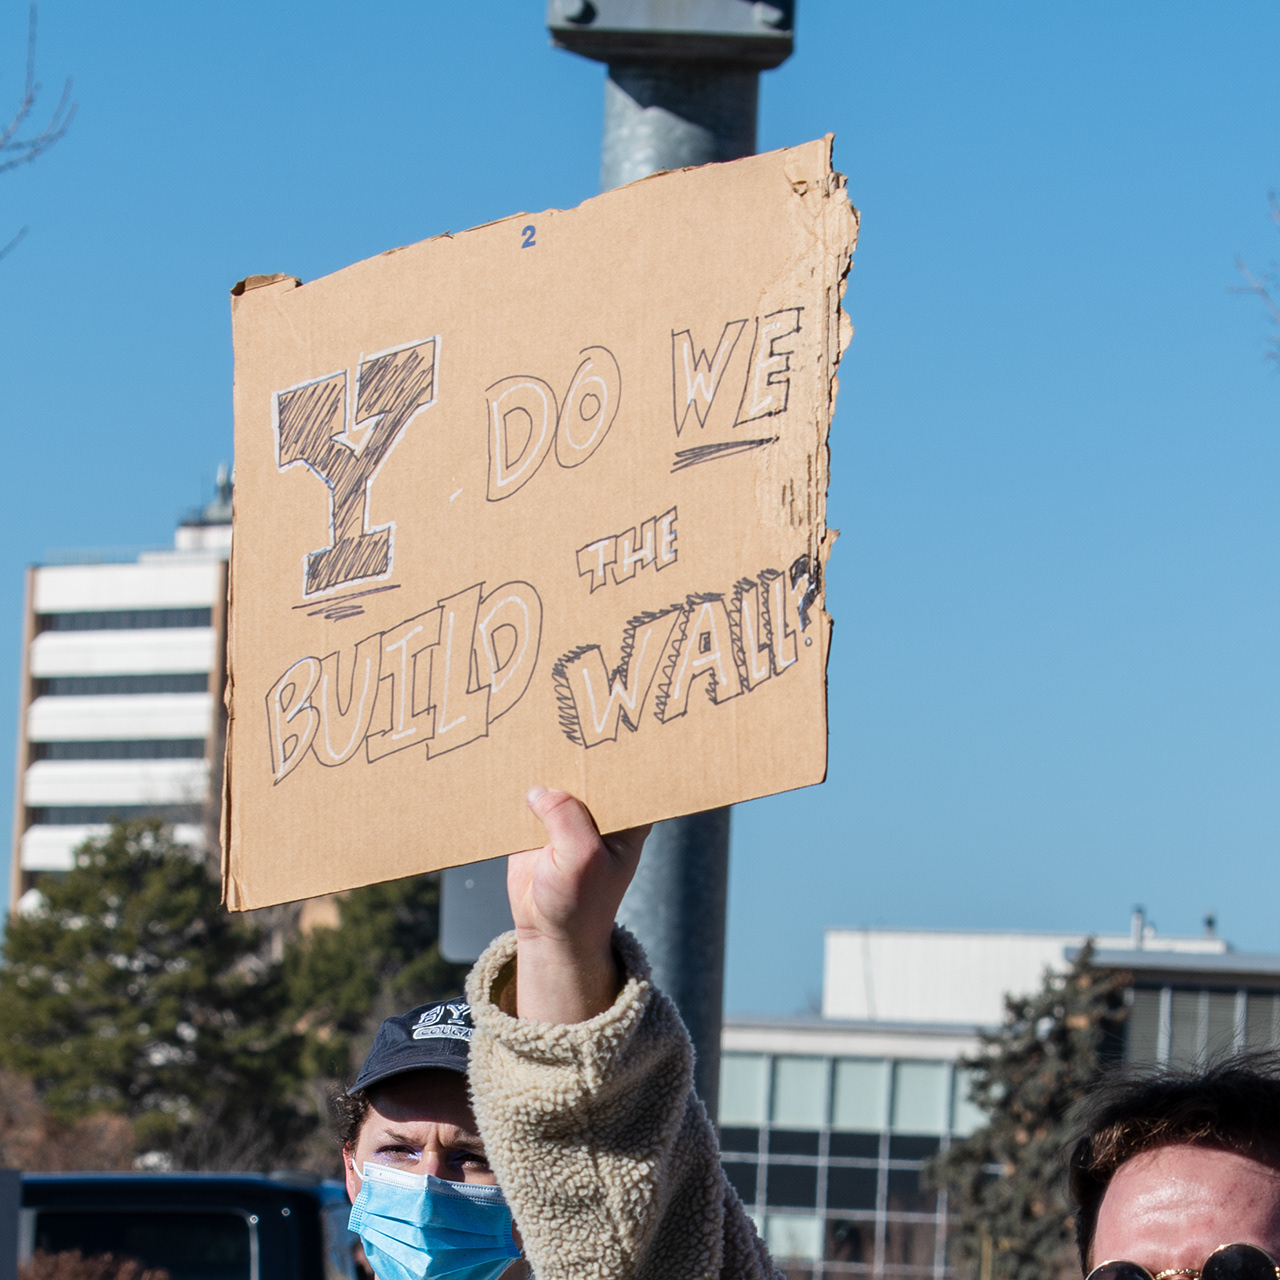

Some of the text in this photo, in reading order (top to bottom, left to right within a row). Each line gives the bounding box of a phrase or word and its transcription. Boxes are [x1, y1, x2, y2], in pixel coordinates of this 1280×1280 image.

[521, 225, 536, 249] 2
[271, 306, 805, 601] Y DO WE
[576, 506, 678, 593] THE
[266, 553, 823, 786] BUILD WALL?
[420, 1027, 473, 1038] COUGA
